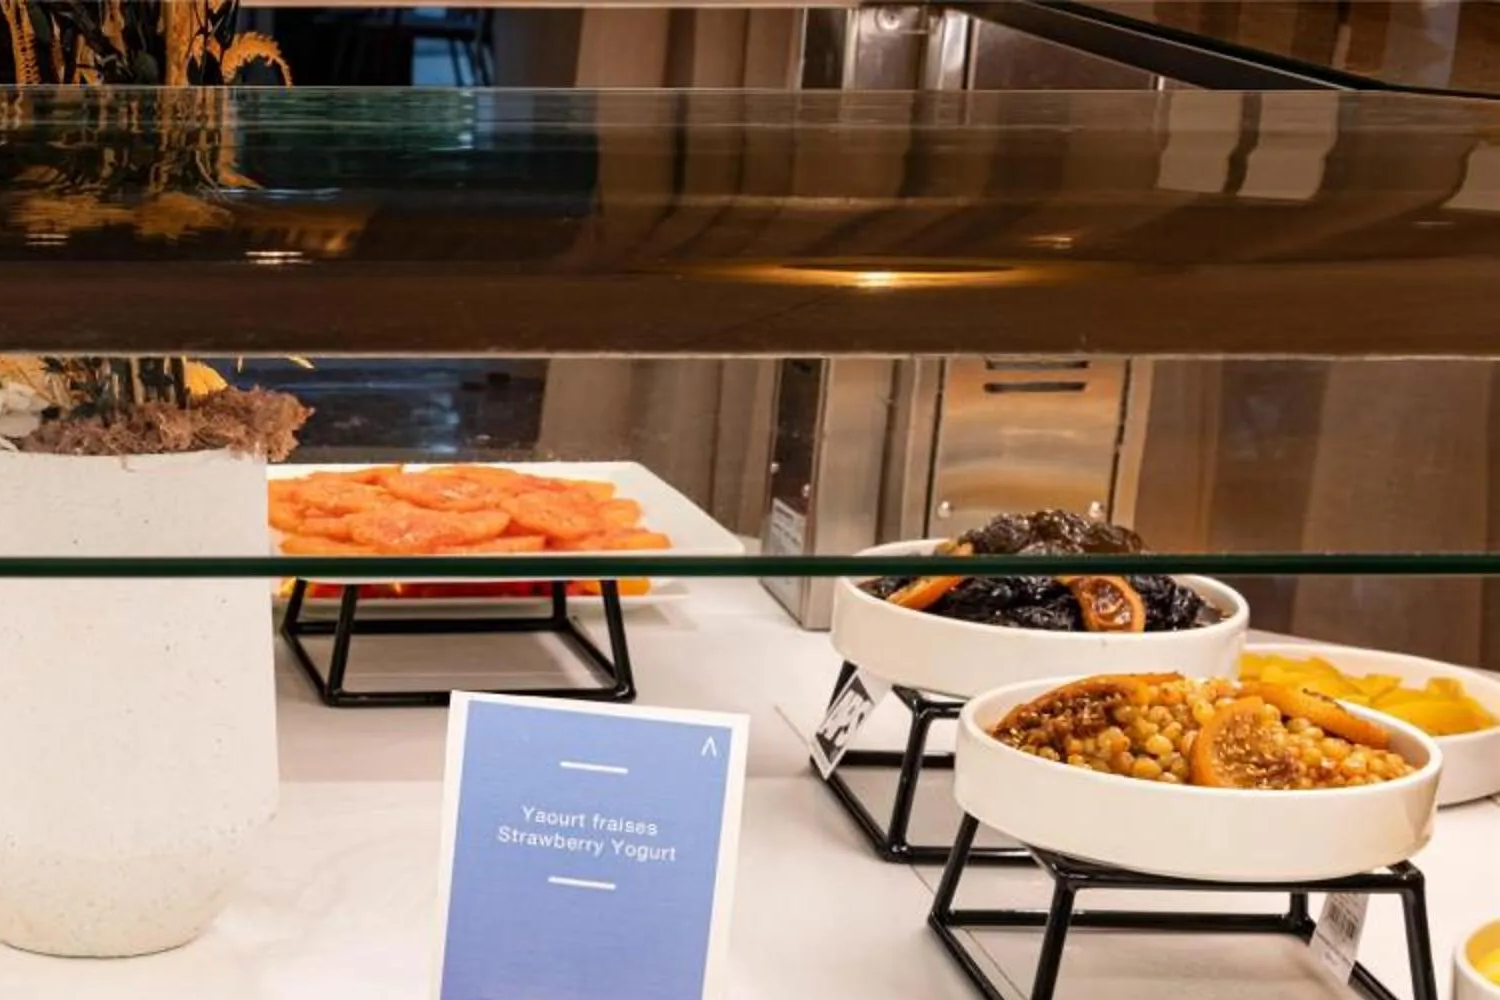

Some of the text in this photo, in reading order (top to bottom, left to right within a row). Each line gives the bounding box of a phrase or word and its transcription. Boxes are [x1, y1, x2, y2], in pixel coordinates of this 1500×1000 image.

[522, 804, 658, 837] Yaourt fraises
[497, 825, 677, 862] Strawberry Yogurt
